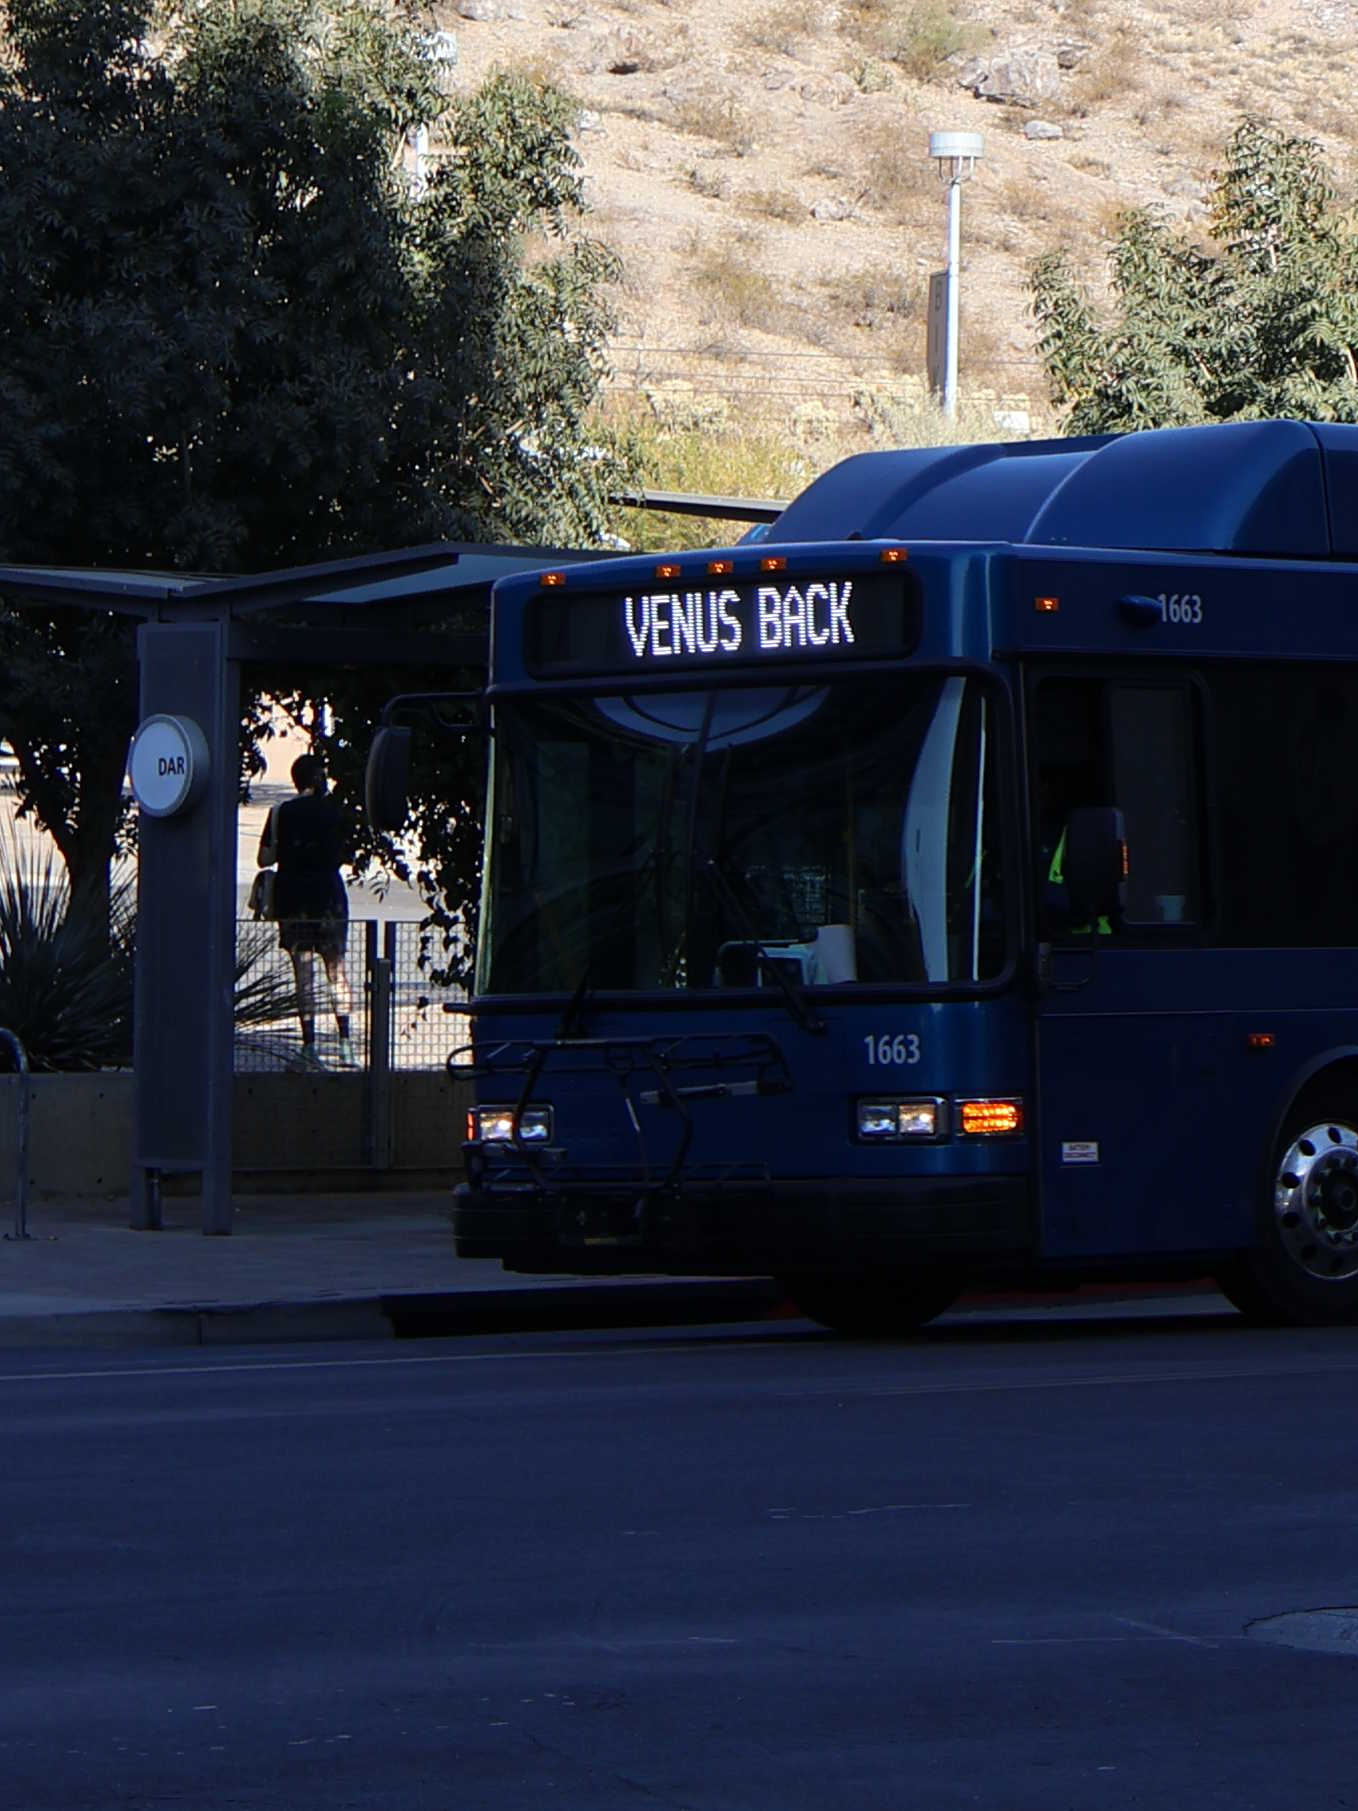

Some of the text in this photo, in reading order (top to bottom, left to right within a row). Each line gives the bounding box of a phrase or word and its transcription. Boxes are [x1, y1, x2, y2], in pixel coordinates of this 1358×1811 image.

[624, 580, 856, 658] VENUS BACK
[1157, 592, 1204, 624] 1663
[158, 756, 185, 776] DAR
[863, 1032, 921, 1065] 1663
